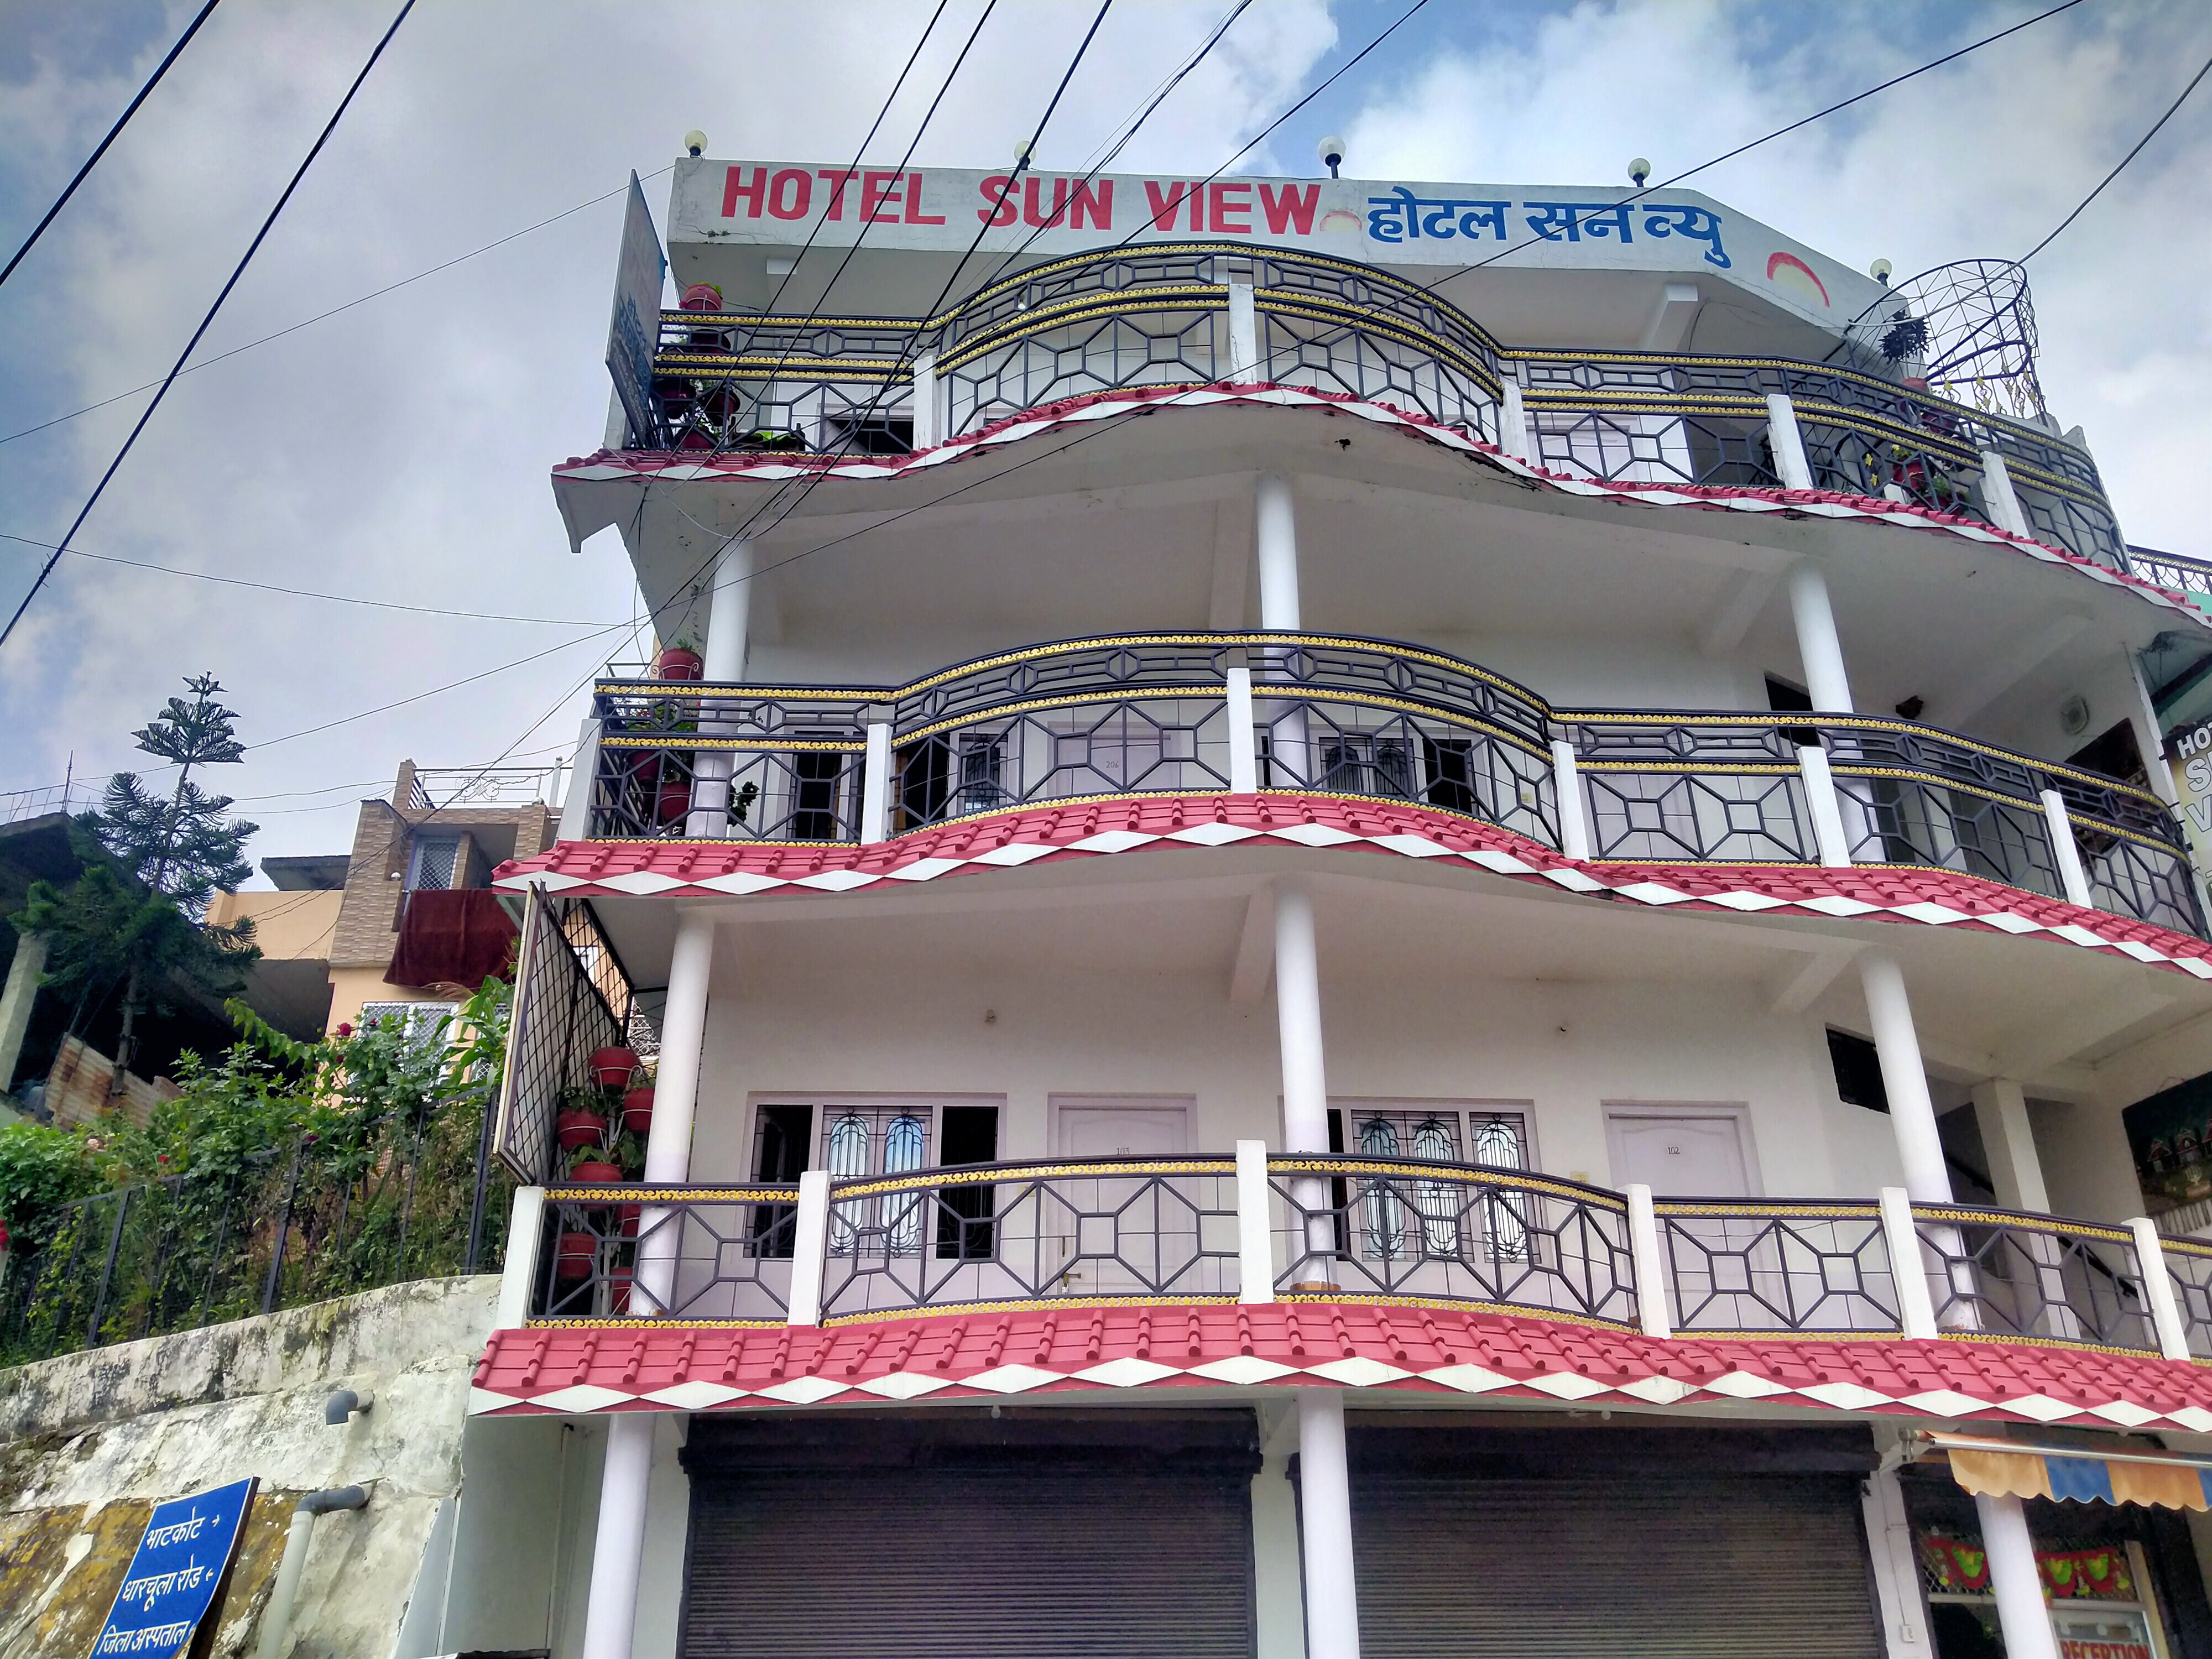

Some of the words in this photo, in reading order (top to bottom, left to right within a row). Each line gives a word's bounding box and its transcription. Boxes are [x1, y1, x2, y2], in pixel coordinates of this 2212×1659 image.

[721, 165, 946, 226] HOTEL
[978, 175, 1113, 230] SUN
[1144, 181, 1321, 236] VIEW
[1366, 185, 1513, 244] होटल
[1522, 201, 1636, 244] सन
[1117, 1147, 1130, 1155] 103
[1667, 1146, 1680, 1155] 102
[146, 1505, 206, 1550] भाटकोट
[121, 1572, 177, 1612] धारचूला
[178, 1553, 205, 1592] रोड
[96, 1624, 136, 1655] जिला
[131, 1620, 191, 1651] अस्पताल
